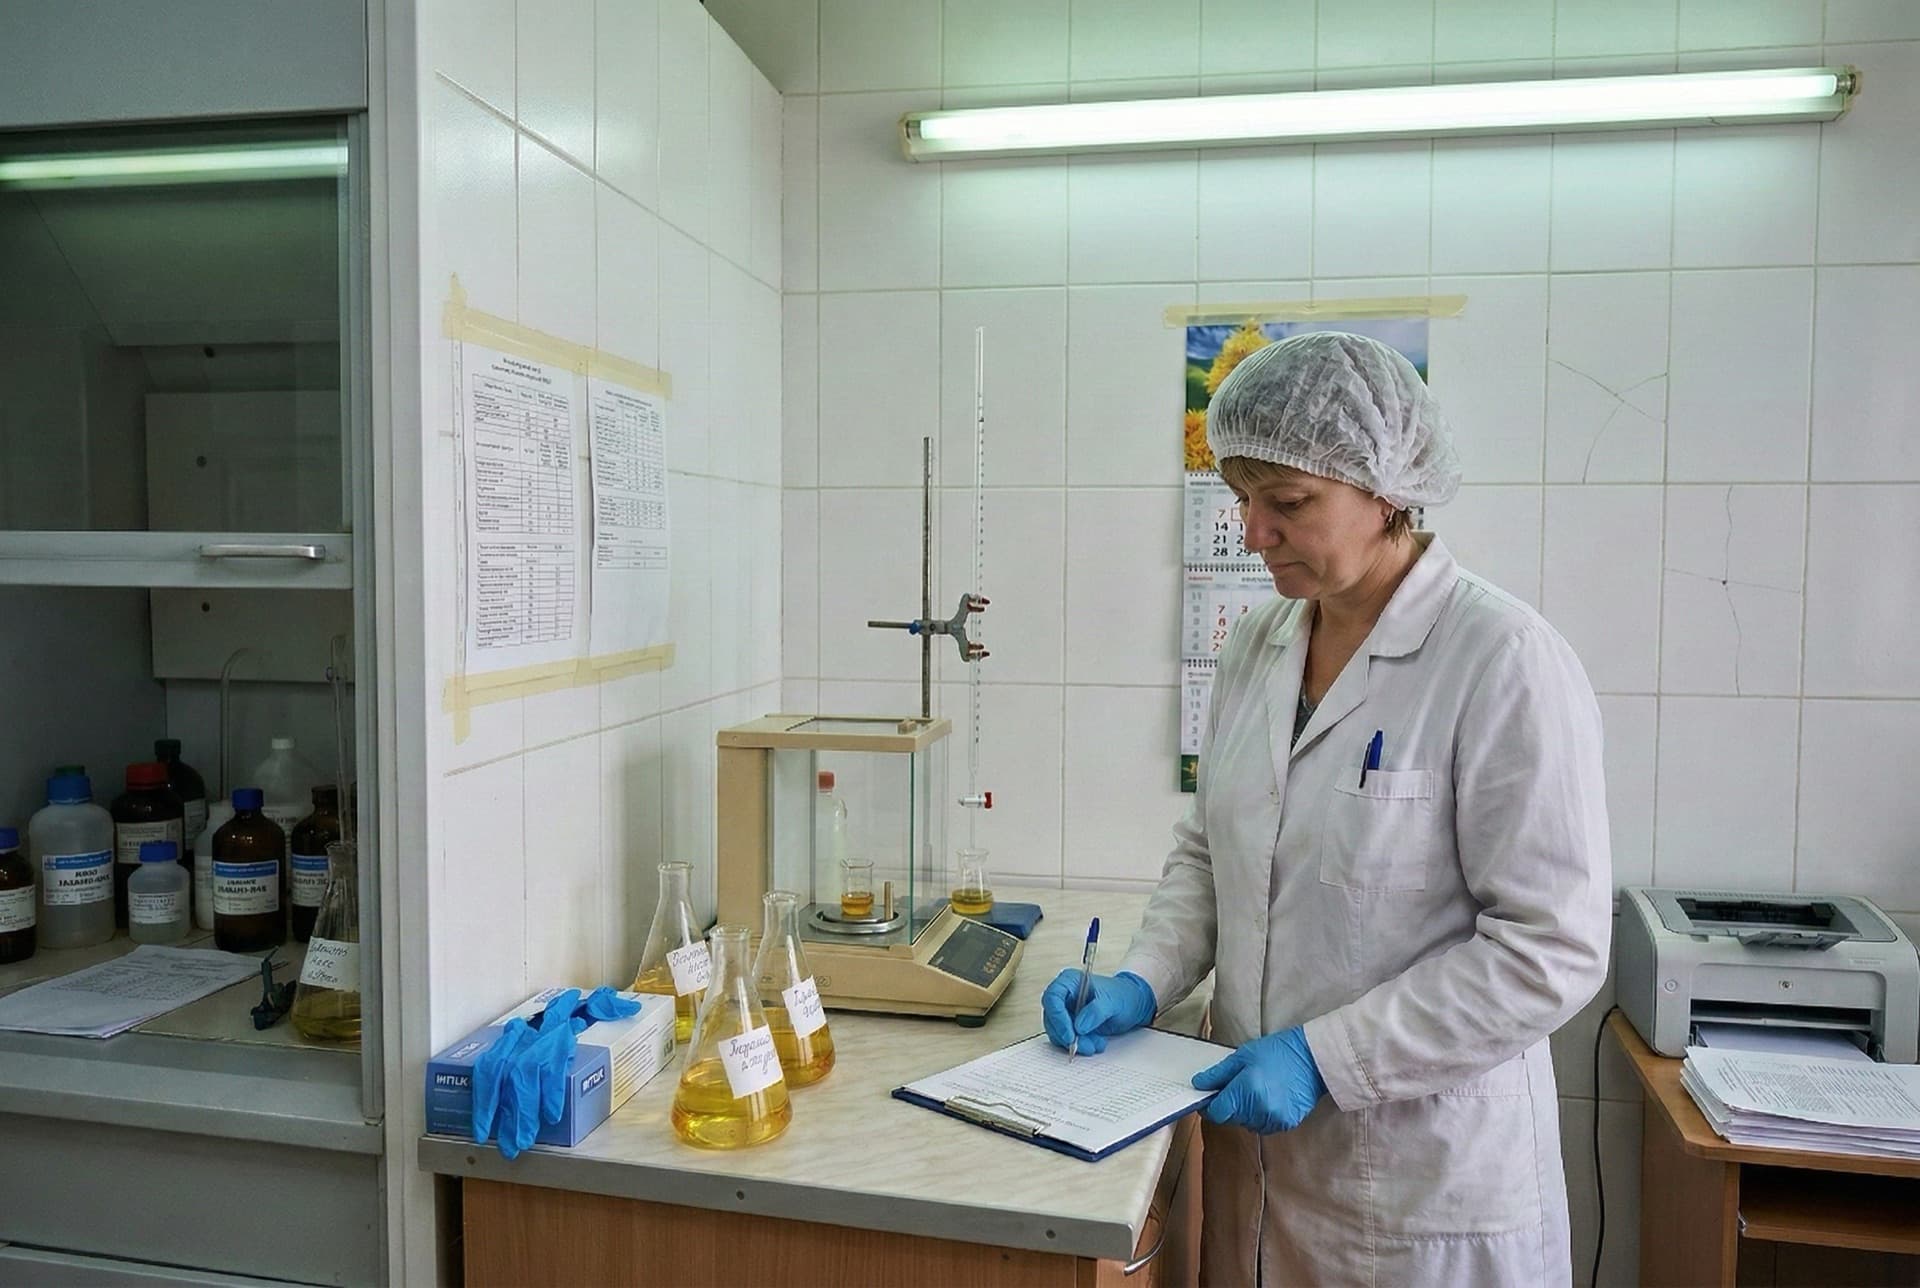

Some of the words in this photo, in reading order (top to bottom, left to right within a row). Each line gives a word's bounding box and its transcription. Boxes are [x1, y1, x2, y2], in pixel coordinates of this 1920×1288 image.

[1215, 521, 1229, 532] 14
[1213, 534, 1227, 545] 21
[1212, 547, 1229, 557] 28
